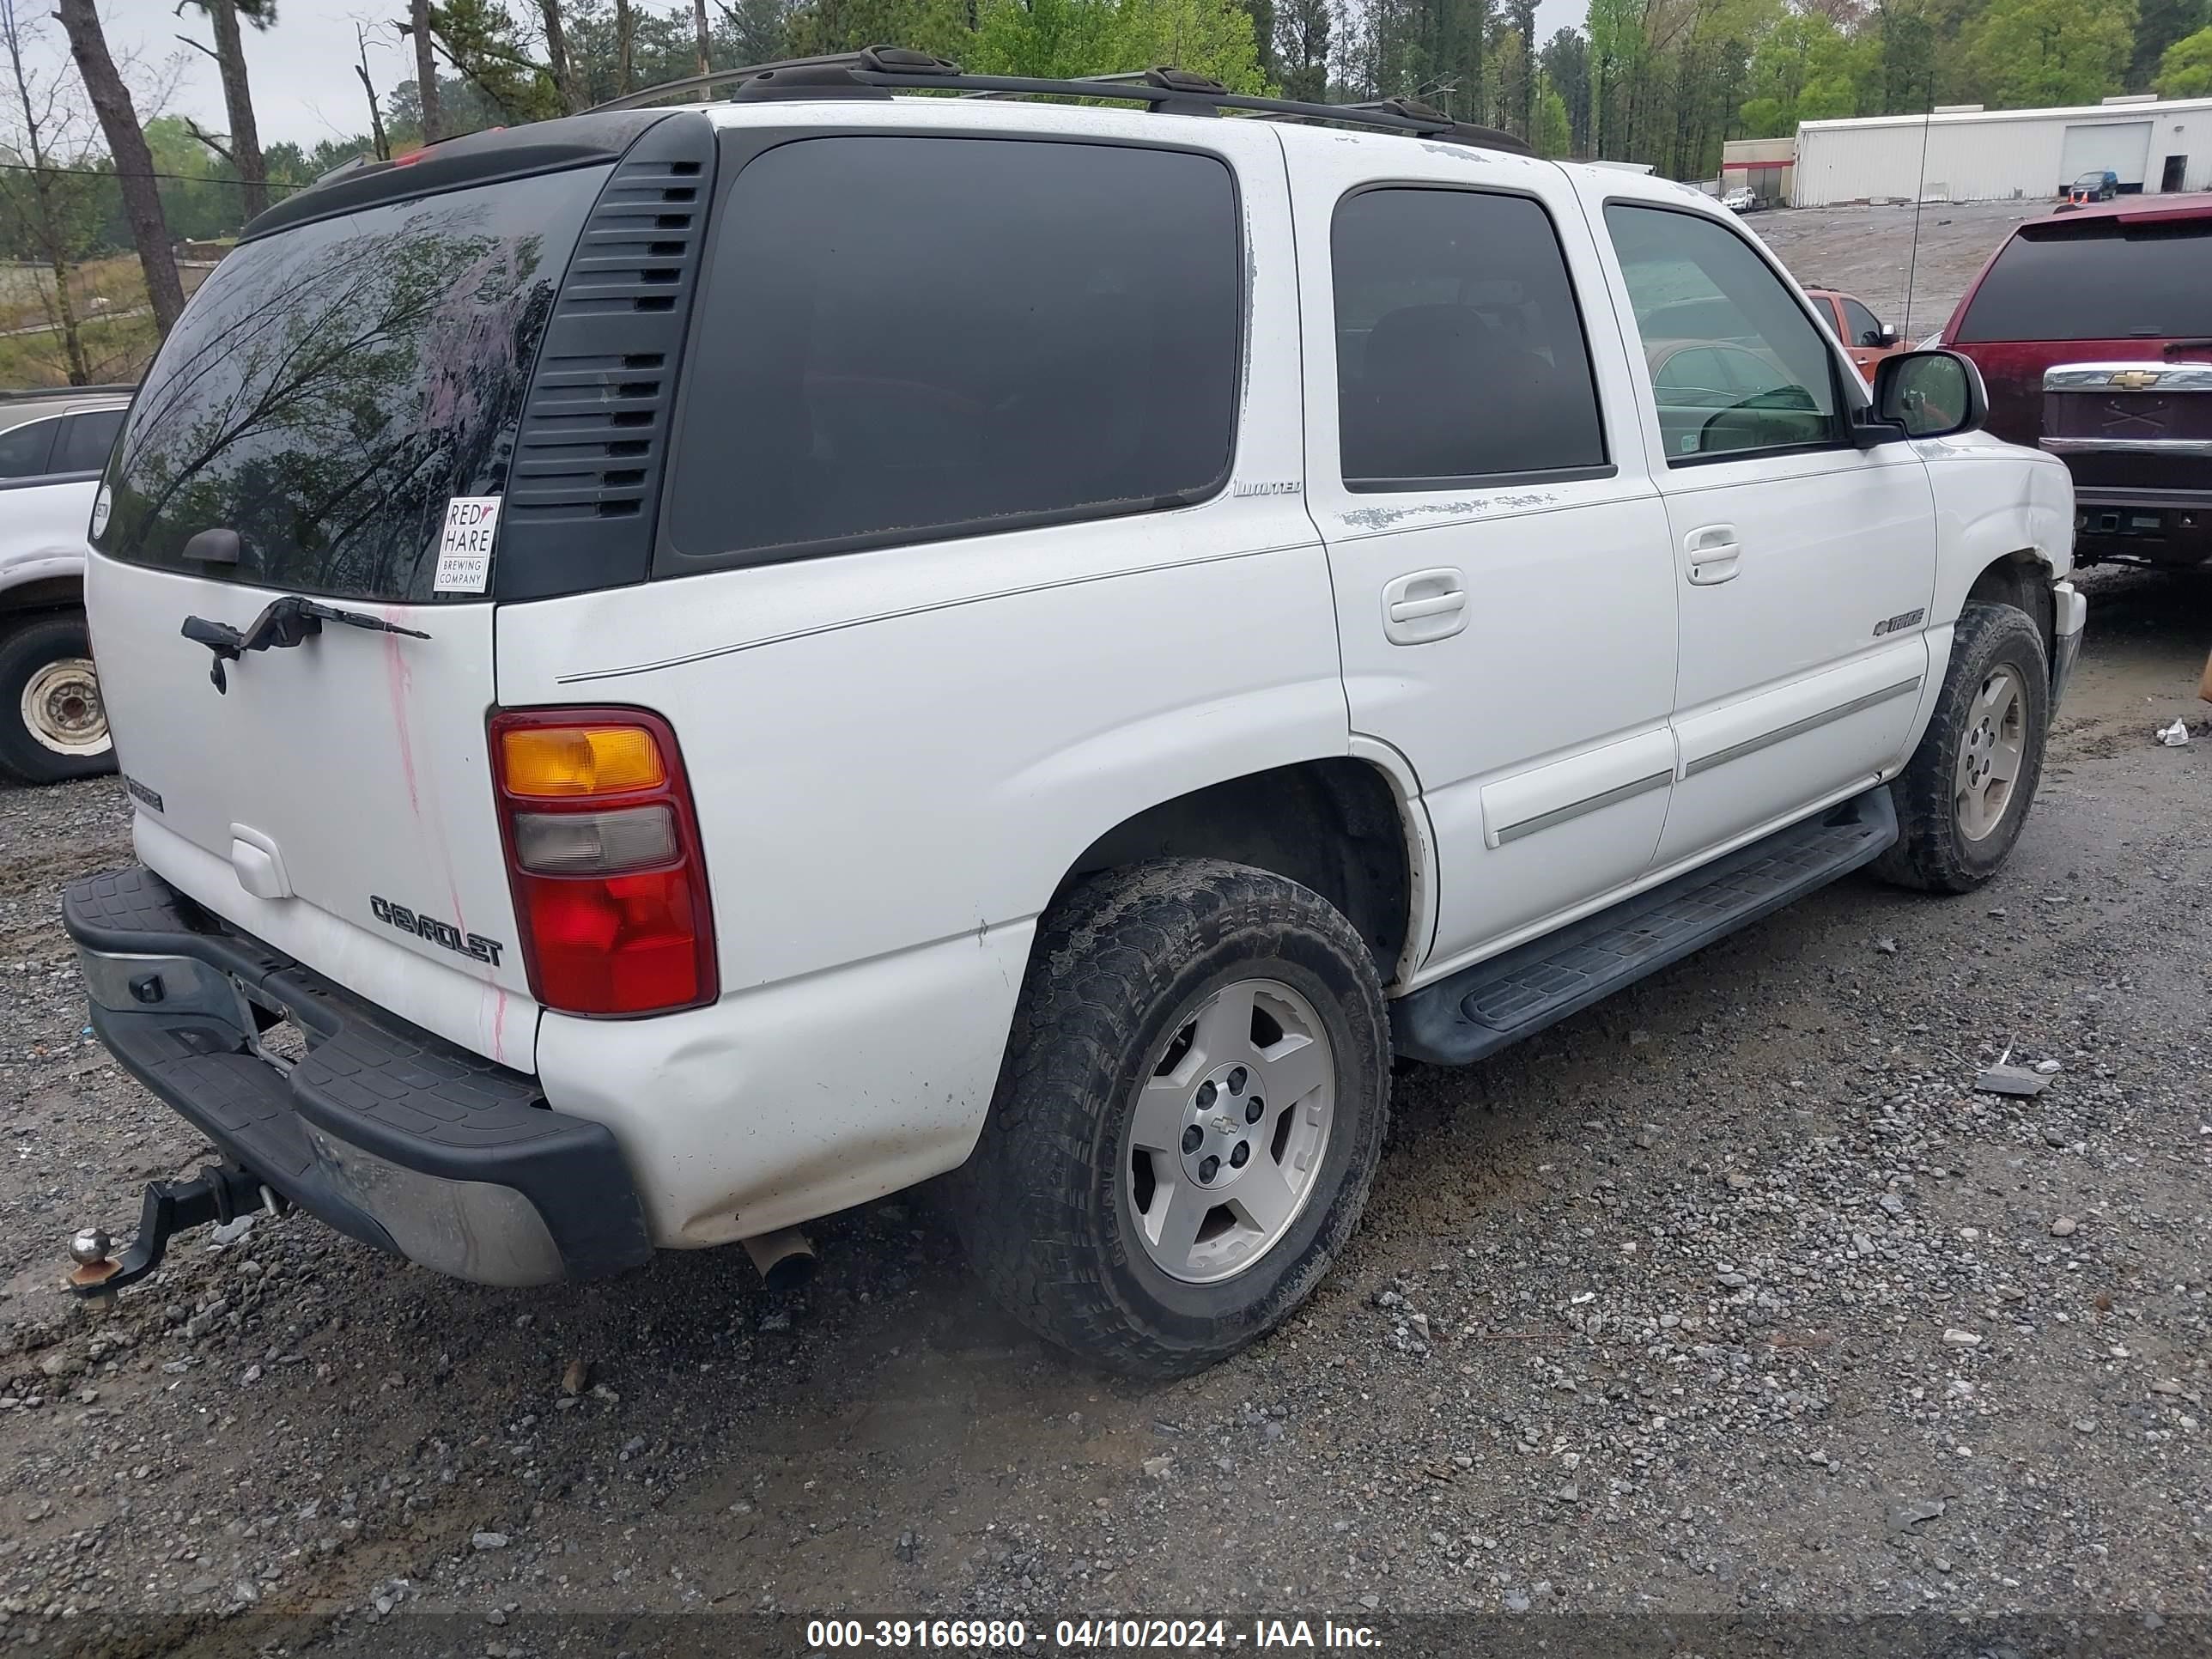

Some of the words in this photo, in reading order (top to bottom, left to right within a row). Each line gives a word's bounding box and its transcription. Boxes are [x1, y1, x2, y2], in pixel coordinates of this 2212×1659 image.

[1233, 479, 1302, 497] LIMITED
[450, 504, 481, 526] RED
[445, 530, 489, 551] HARE
[443, 560, 482, 571] BREWING
[440, 574, 482, 585] COMPANY
[1887, 608, 1925, 633] TAHOE
[369, 895, 503, 967] CHEVROLET
